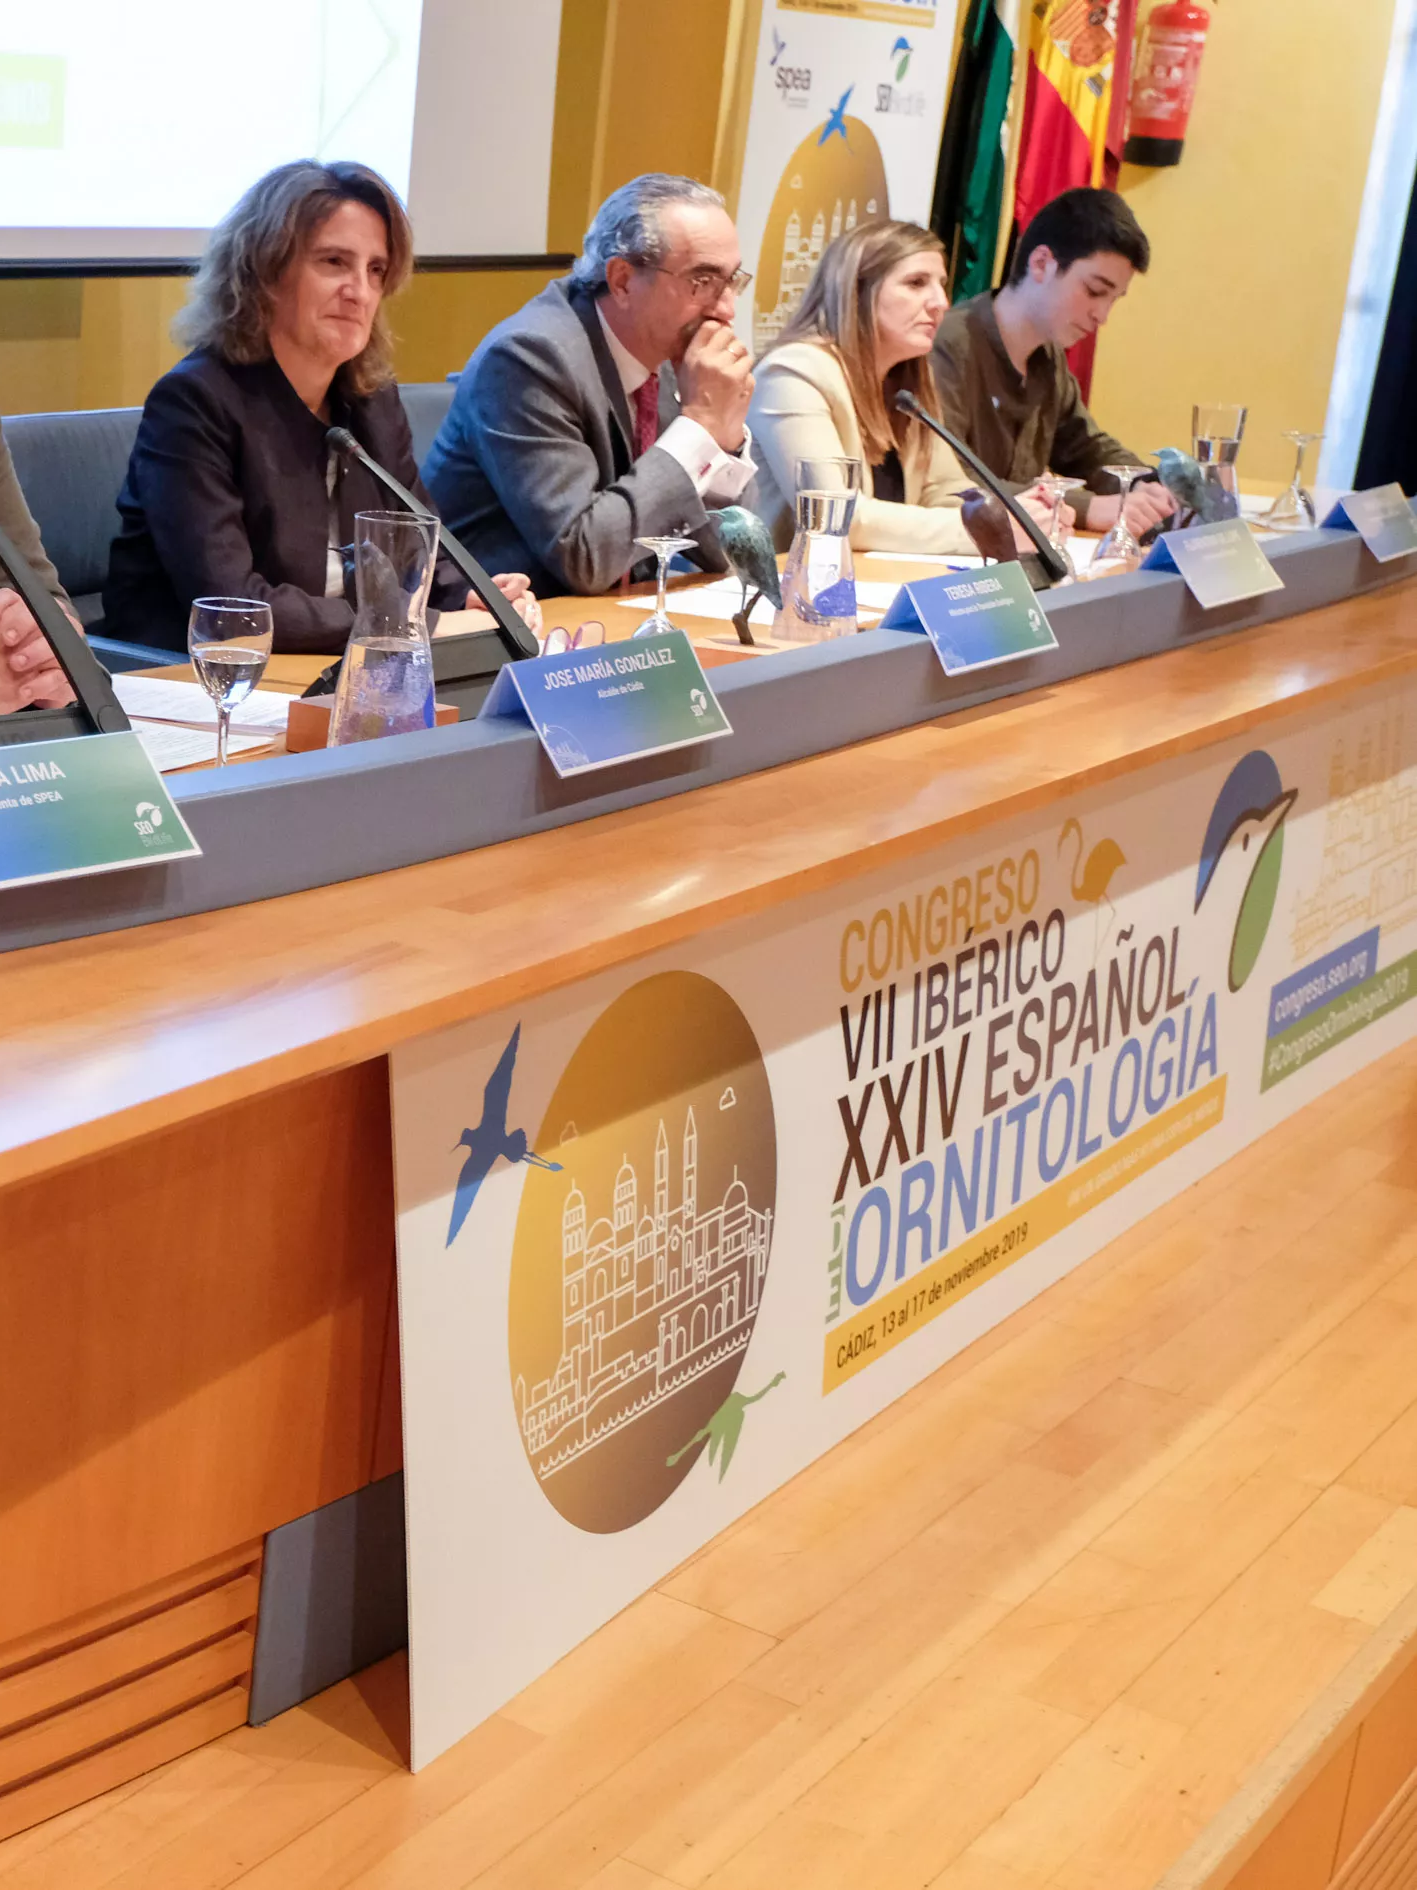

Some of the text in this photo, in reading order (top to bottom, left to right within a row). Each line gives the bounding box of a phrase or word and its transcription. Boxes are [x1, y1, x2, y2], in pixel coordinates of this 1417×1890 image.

[943, 583, 976, 600] TERESA
[544, 647, 677, 691] JOSE MARÍA GONZÁLEZ
[10, 761, 67, 784] LIMA
[20, 794, 35, 806] de
[33, 790, 64, 804] SPEA
[840, 848, 1040, 993] CONGRESO
[840, 908, 1066, 1081] VII IBÉRICO
[1274, 950, 1368, 1022] congreso.seo.org
[833, 1032, 971, 1204] XXIV
[983, 924, 1186, 1117] ESPAÑOL
[846, 976, 1218, 1306] ORNITOLOGÍA
[836, 1221, 1030, 1368] CÁDIZ, 13 al 17 de noviembre 2019
